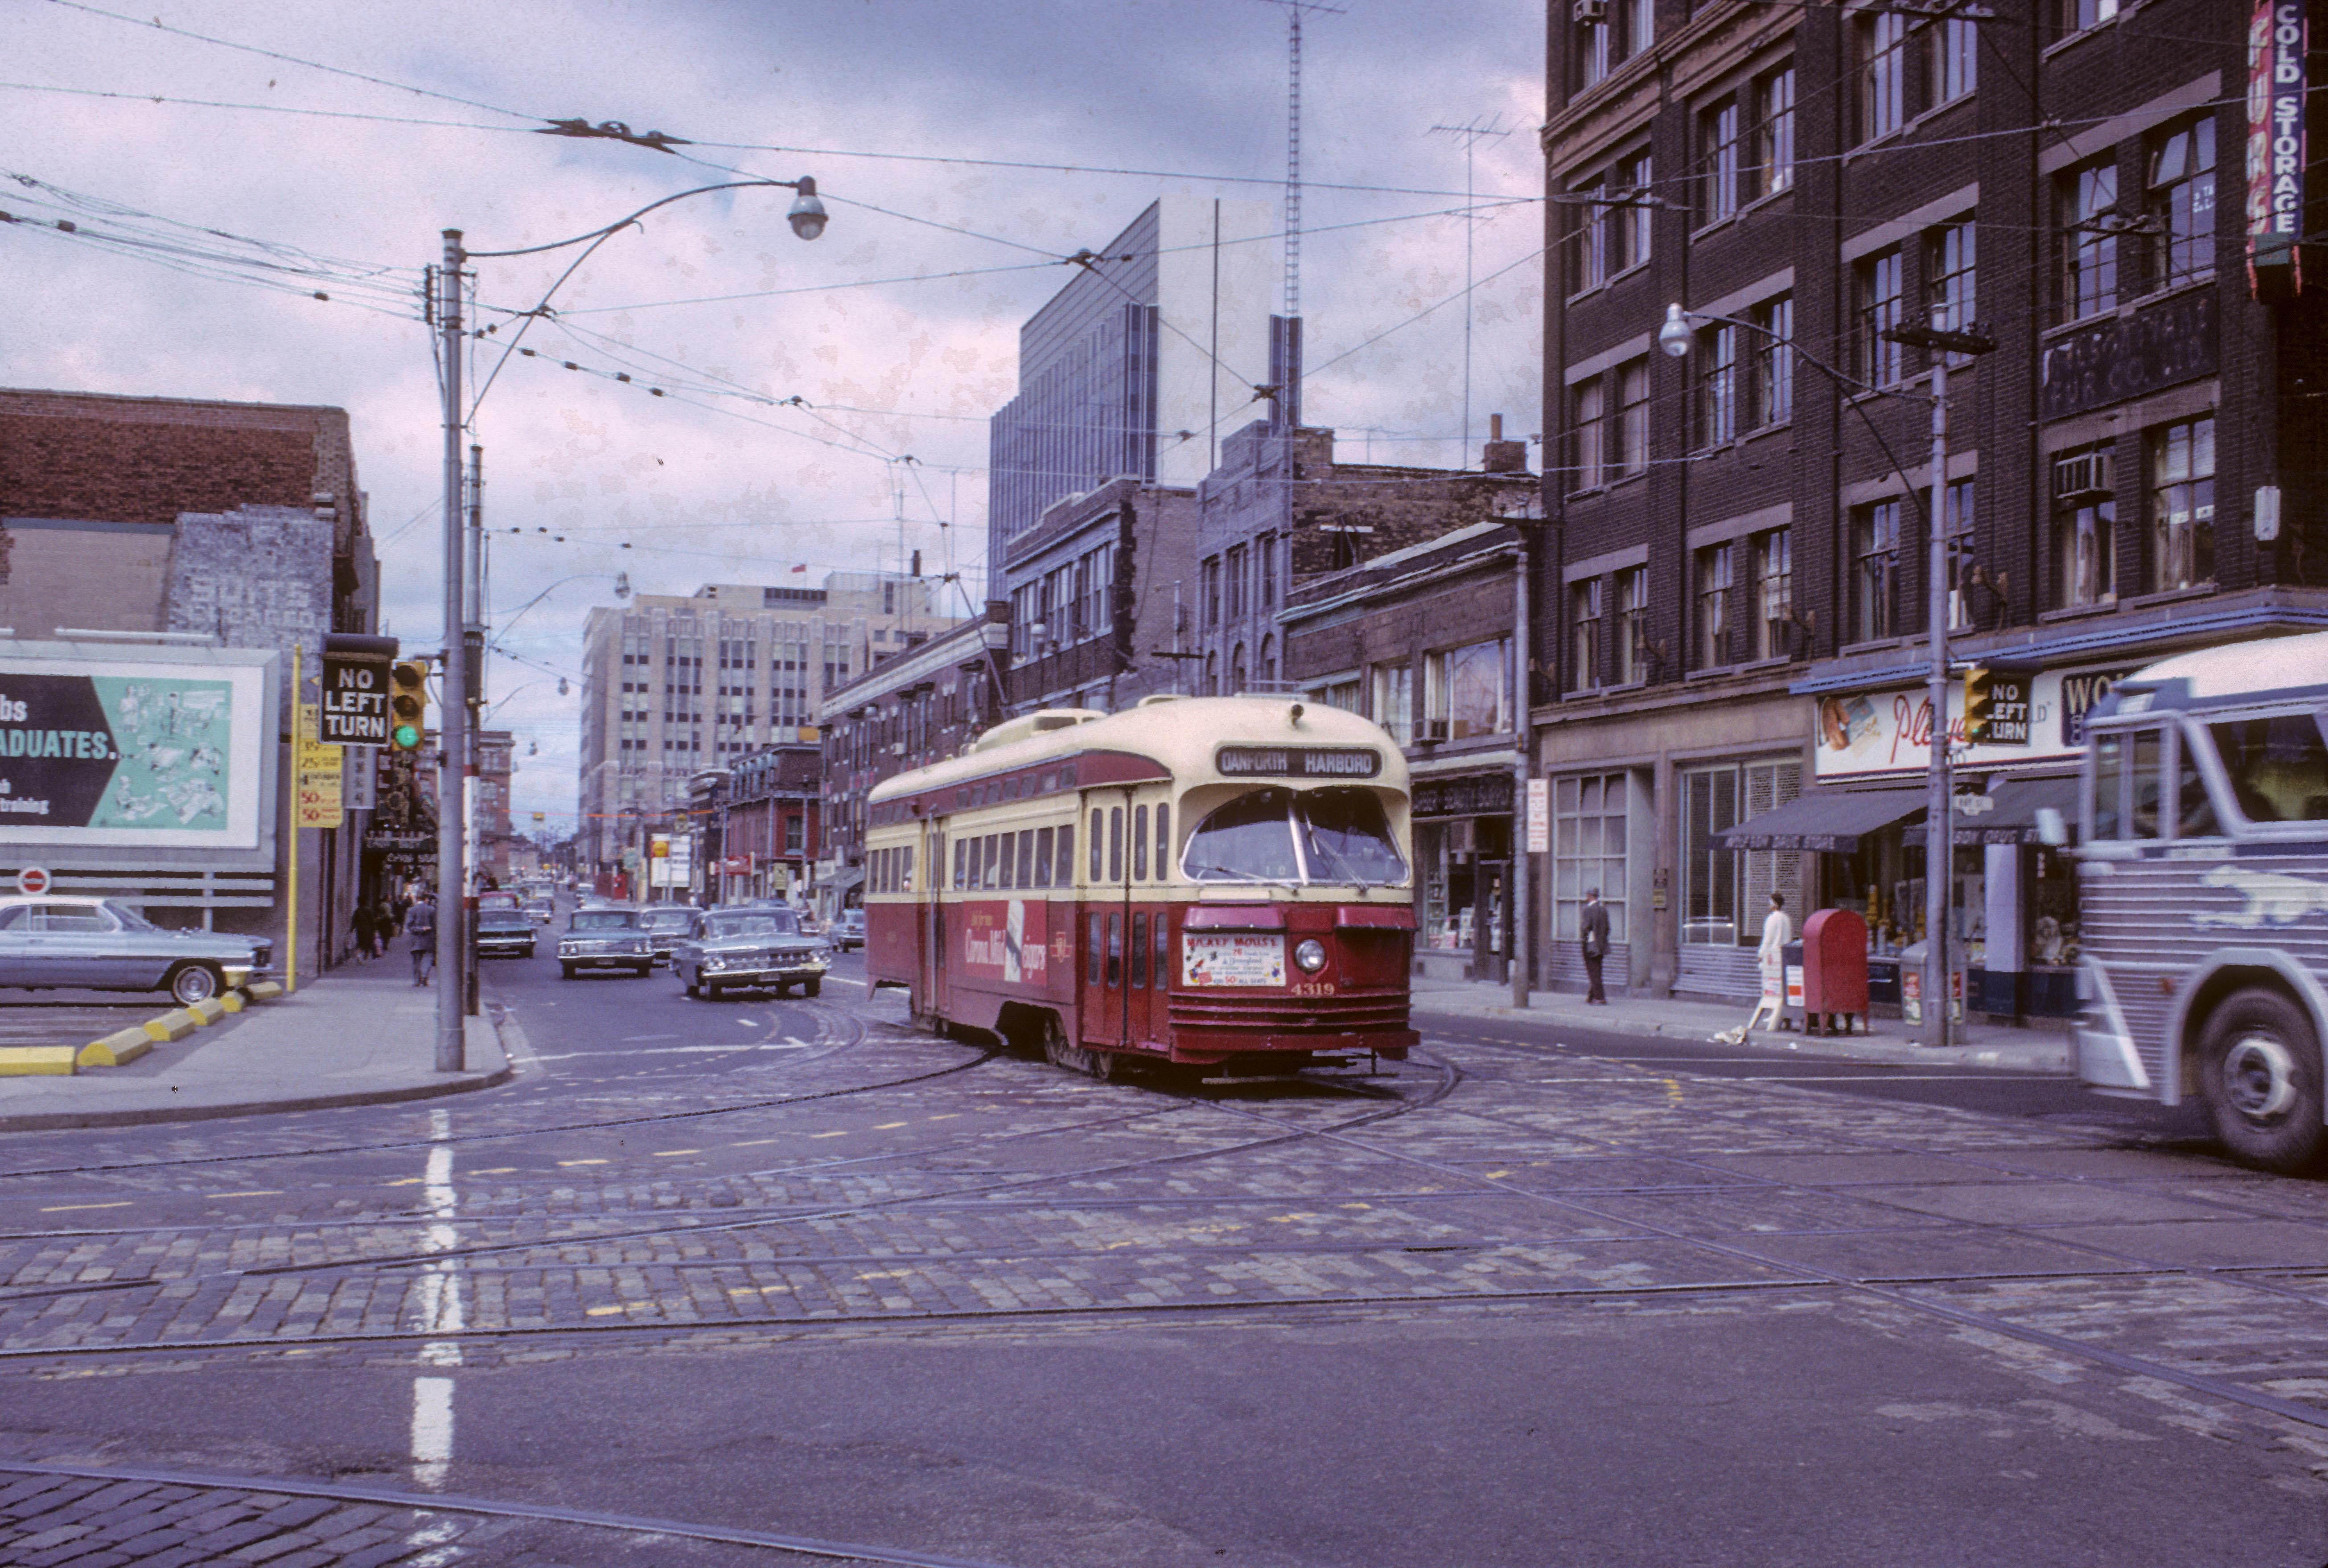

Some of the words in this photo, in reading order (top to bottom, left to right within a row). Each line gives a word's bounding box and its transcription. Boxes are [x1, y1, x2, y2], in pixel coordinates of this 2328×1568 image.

[2275, 4, 2301, 83] COLD
[2274, 96, 2301, 233] STORAGE
[338, 668, 374, 689] NO
[325, 691, 386, 713] LEFT
[1991, 684, 2019, 701] NO
[325, 715, 386, 738] TURN
[1986, 722, 2027, 740] URN
[1222, 751, 1288, 771] DANFORTH
[1305, 753, 1373, 774] HARBORD
[1187, 937, 1231, 948] MICKEY
[1234, 937, 1277, 948] MOUSE
[1291, 982, 1335, 996] 4319
